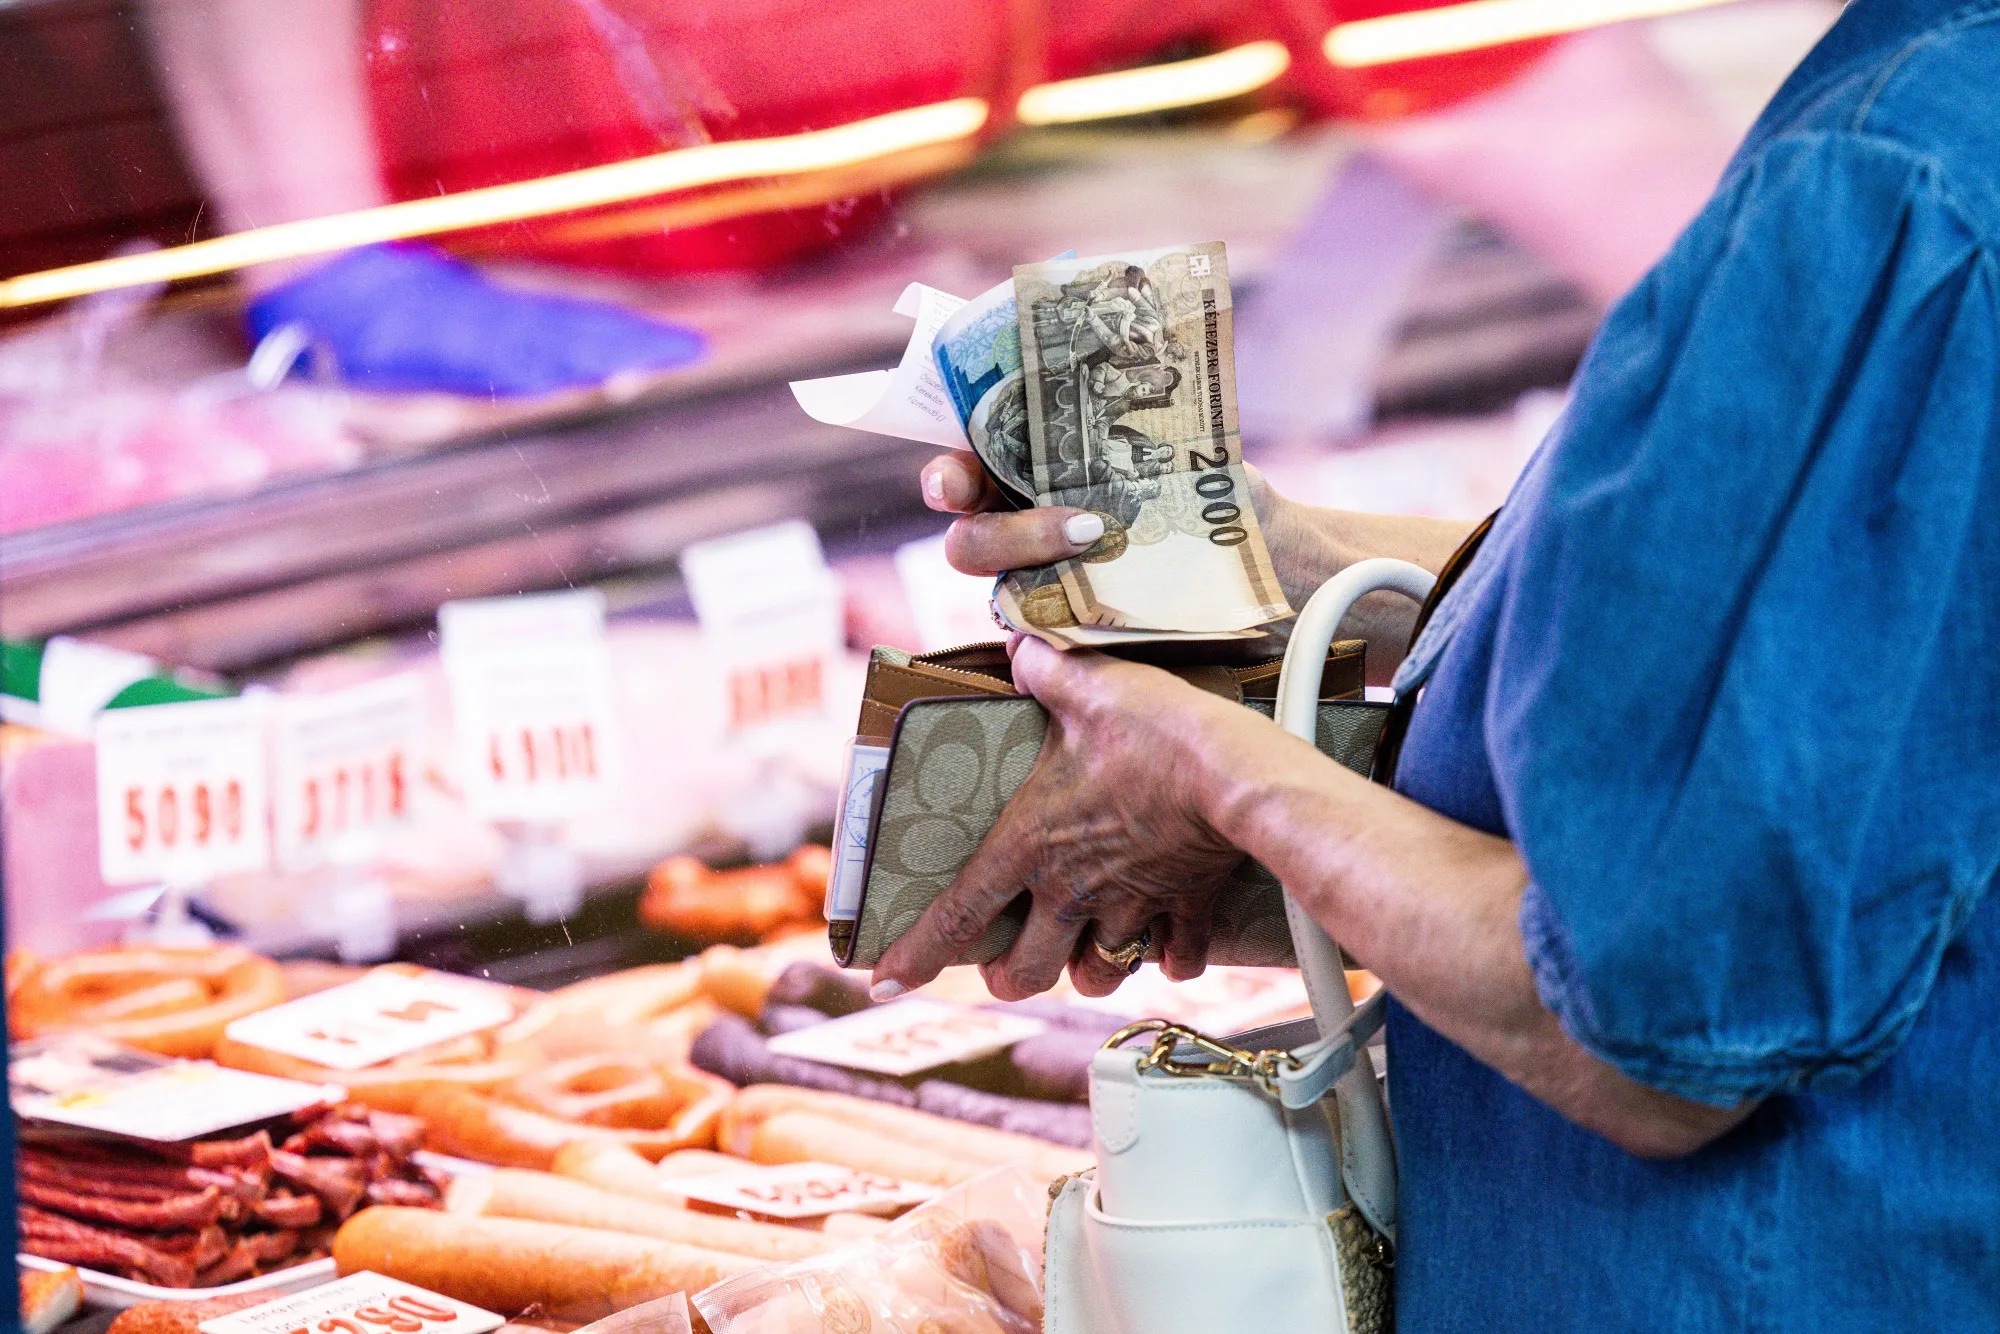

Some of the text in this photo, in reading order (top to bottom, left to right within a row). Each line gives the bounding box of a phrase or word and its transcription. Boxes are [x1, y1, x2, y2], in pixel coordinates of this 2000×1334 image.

[1203, 299, 1224, 429] KÉTEZER FORINT
[1190, 446, 1248, 546] 2000
[288, 1296, 458, 1334] 280
